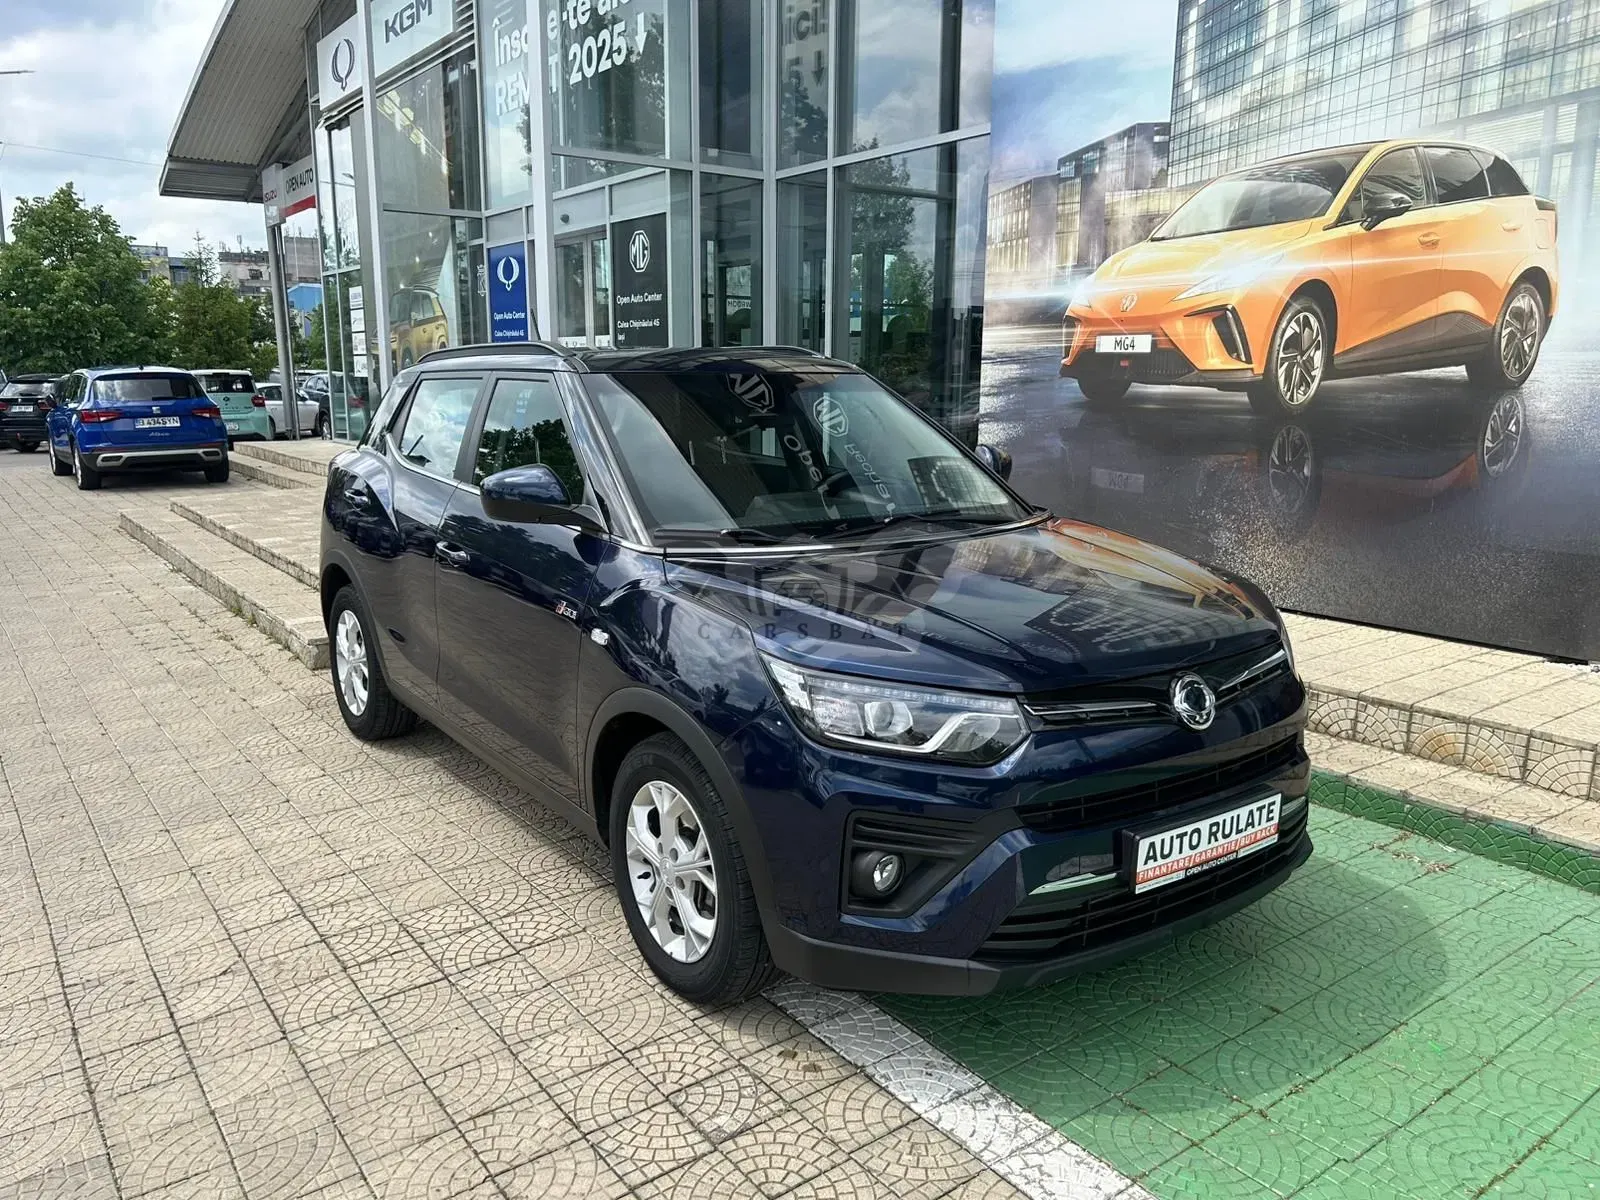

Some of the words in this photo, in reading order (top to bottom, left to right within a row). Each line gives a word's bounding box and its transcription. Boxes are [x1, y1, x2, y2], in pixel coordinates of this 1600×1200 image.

[384, 0, 433, 44] KGM
[568, 20, 628, 86] 2025
[286, 173, 299, 194] OPEN
[300, 168, 314, 187] AUTO
[630, 230, 650, 273] MG
[616, 295, 630, 306] Open
[631, 294, 643, 303] Auto
[644, 292, 662, 302] Center
[1113, 337, 1136, 351] MG4
[1143, 827, 1201, 866] AUTO
[1207, 800, 1276, 845] RULATE
[1186, 864, 1202, 876] OPEN
[1202, 860, 1216, 871] AUTO
[1217, 853, 1238, 866] CENTER
